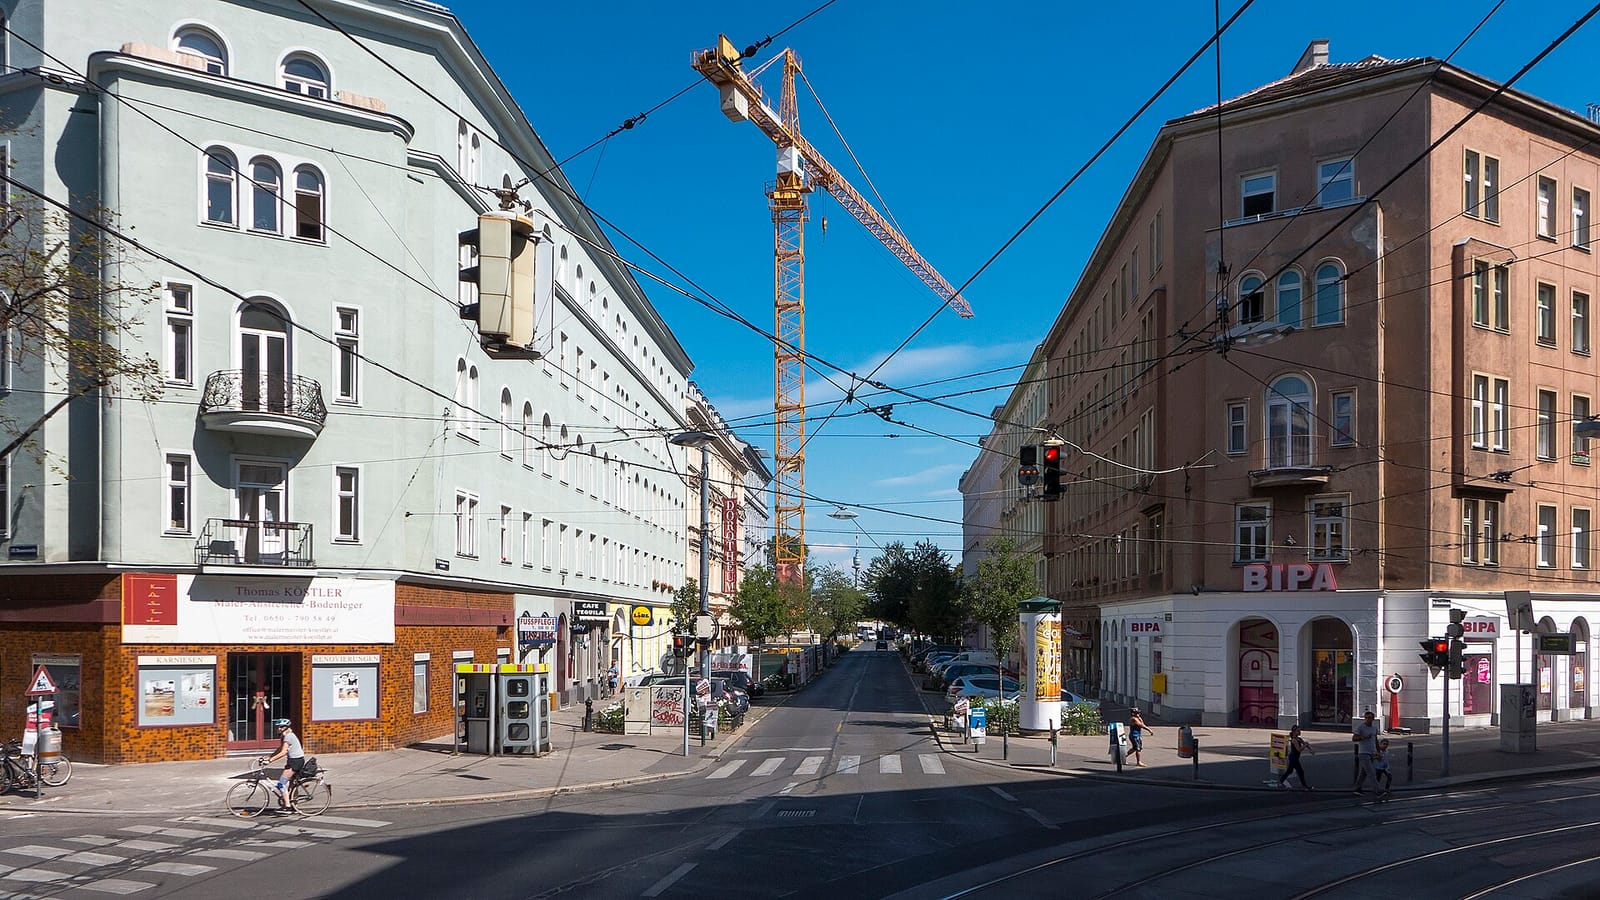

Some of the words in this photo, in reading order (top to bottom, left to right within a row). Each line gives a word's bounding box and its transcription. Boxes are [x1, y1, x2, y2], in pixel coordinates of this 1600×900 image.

[726, 500, 734, 592] DOROTHEUM
[1243, 562, 1338, 592] BIPA
[235, 585, 279, 596] Thomas
[284, 585, 342, 598] KÖSTLER
[520, 618, 555, 626] FUSSPFLEGE
[1131, 622, 1160, 632] BIPA
[1462, 621, 1496, 633] BIPA
